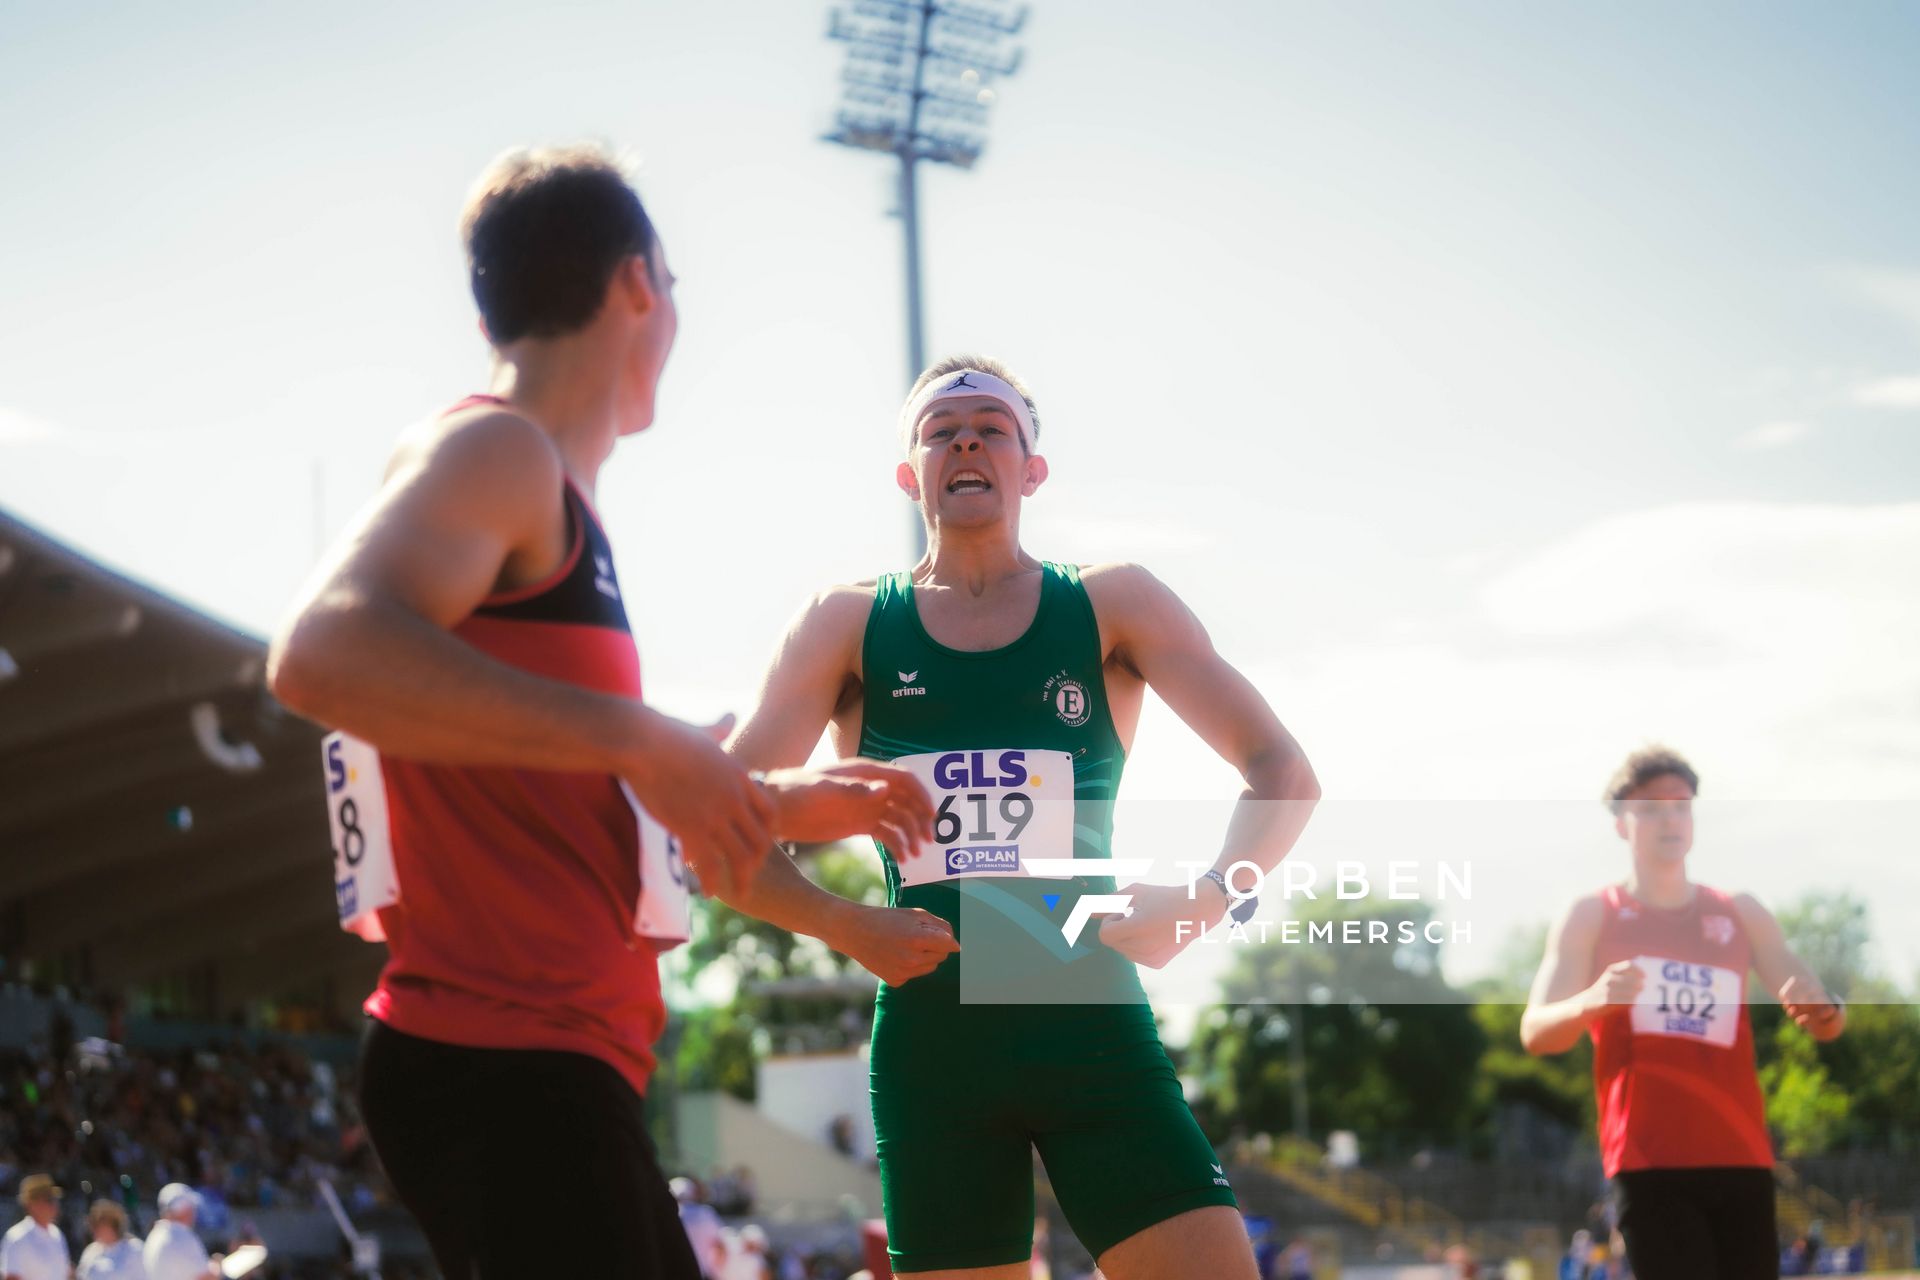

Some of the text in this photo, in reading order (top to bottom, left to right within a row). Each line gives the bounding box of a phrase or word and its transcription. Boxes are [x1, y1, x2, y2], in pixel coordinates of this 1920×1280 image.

[892, 686, 926, 698] erima
[1062, 690, 1079, 715] E
[934, 792, 1034, 845] 619
[975, 850, 1016, 863] PLAN
[1656, 984, 1716, 1021] 102
